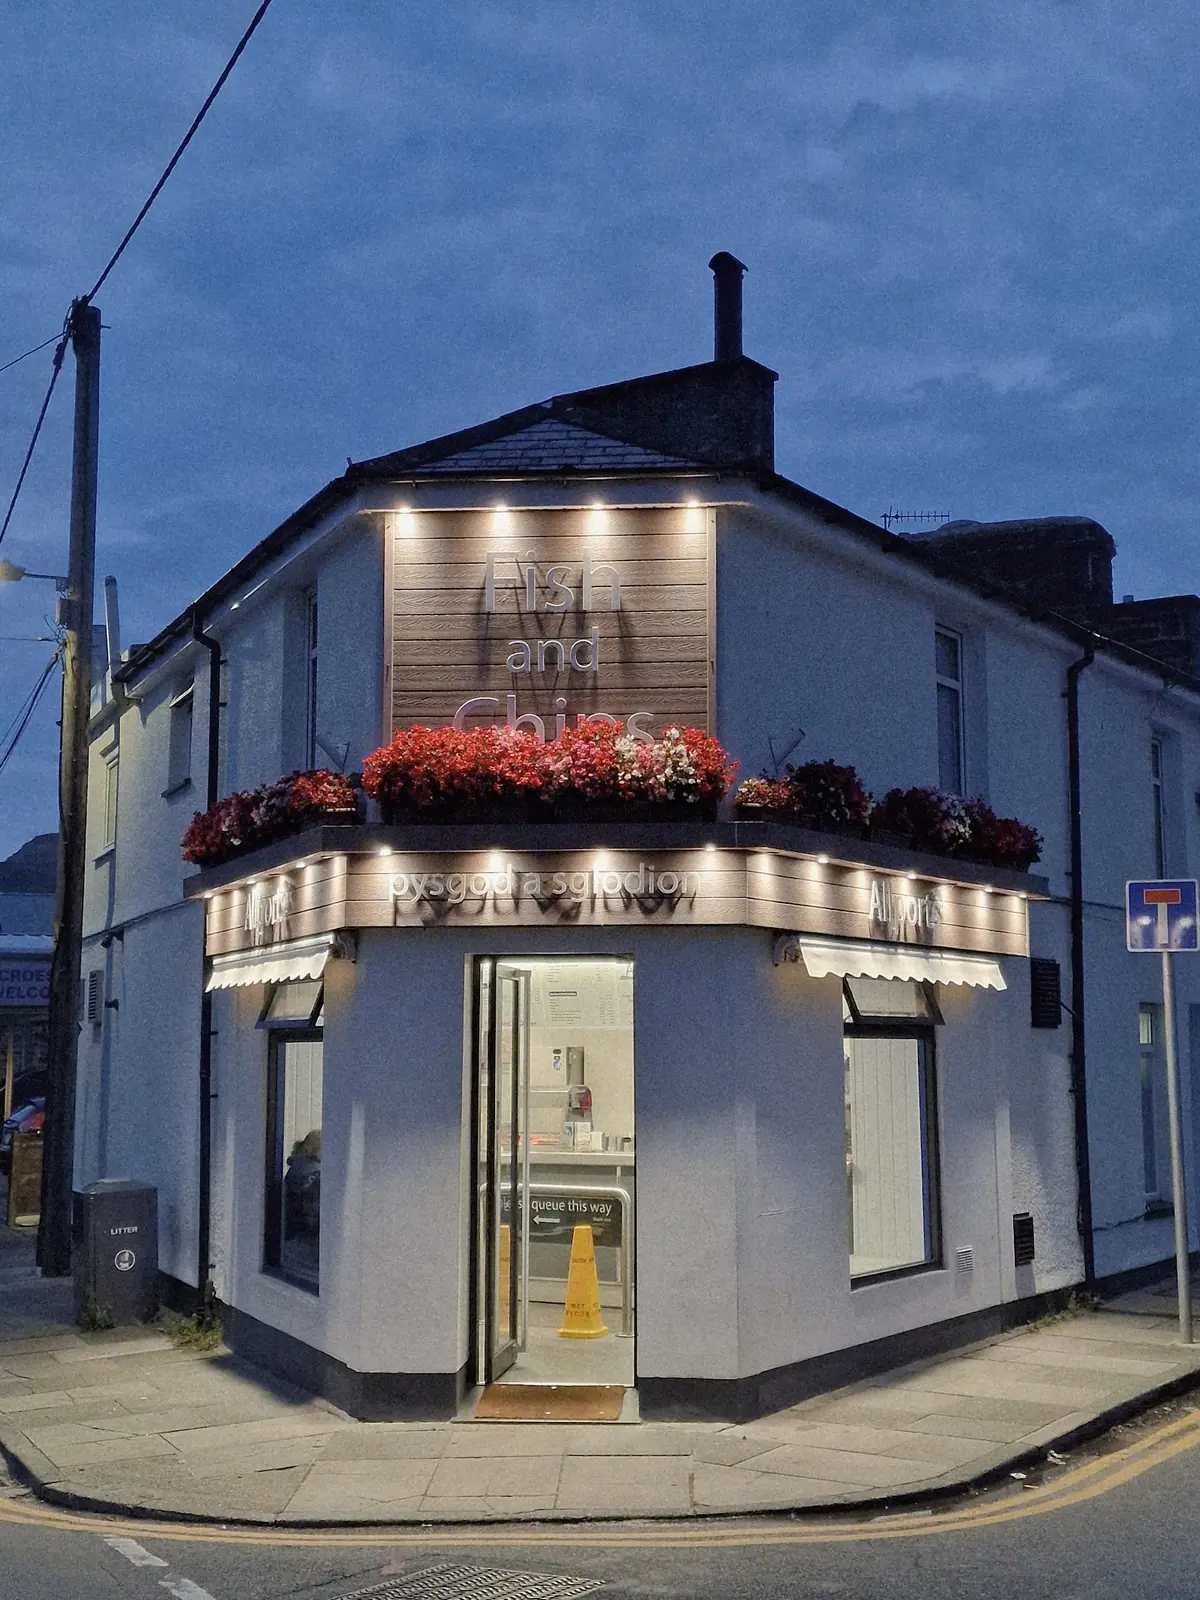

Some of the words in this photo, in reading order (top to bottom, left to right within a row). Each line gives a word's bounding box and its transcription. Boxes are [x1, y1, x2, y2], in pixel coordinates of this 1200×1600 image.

[484, 548, 622, 612] Fish
[506, 625, 599, 674] and
[453, 694, 655, 745] Chis
[388, 863, 514, 904] pysgod
[524, 871, 541, 895] a
[552, 862, 701, 903] sglodion
[531, 1200, 566, 1212] queue
[568, 1199, 588, 1213] this
[590, 1203, 612, 1216] way
[110, 1226, 138, 1236] LITTER
